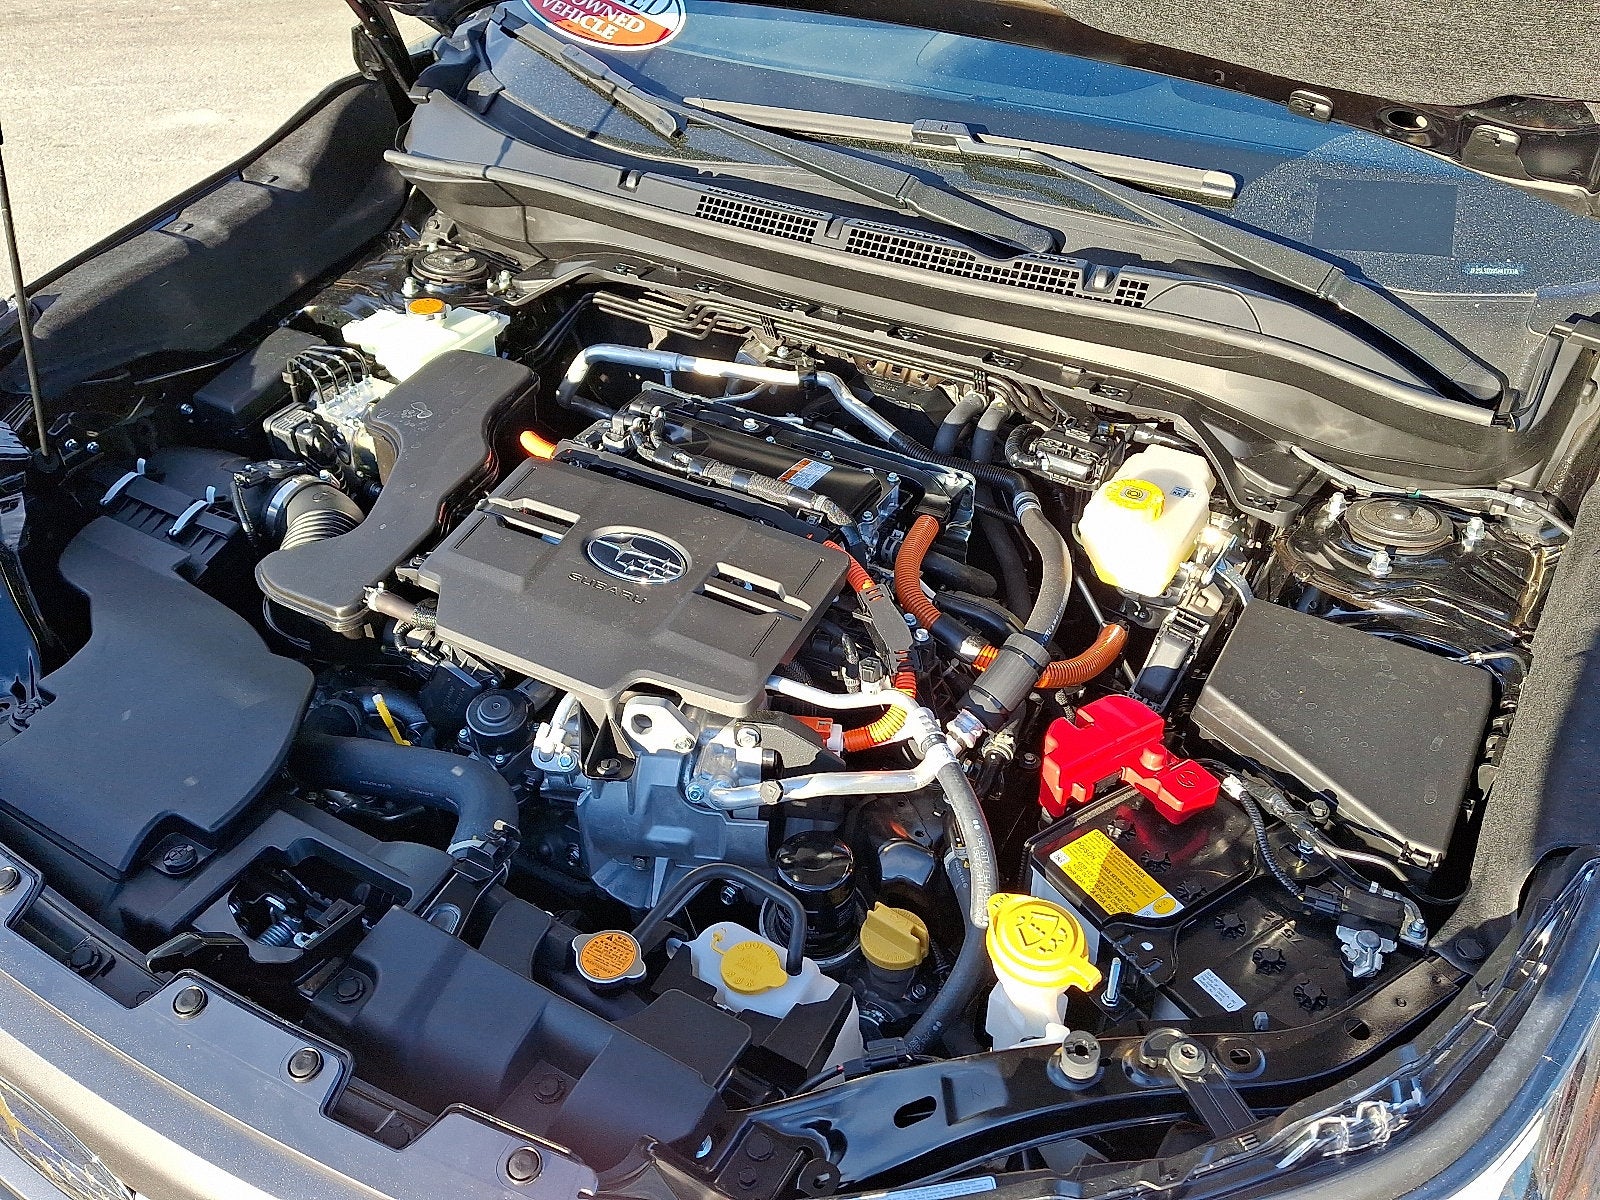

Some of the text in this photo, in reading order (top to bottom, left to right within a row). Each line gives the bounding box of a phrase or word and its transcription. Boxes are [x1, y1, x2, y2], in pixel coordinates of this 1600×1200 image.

[541, 0, 619, 40] VEHICLE
[568, 572, 648, 605] SUBARU
[1075, 840, 1097, 861] POISON
[1092, 830, 1115, 851] DANGER
